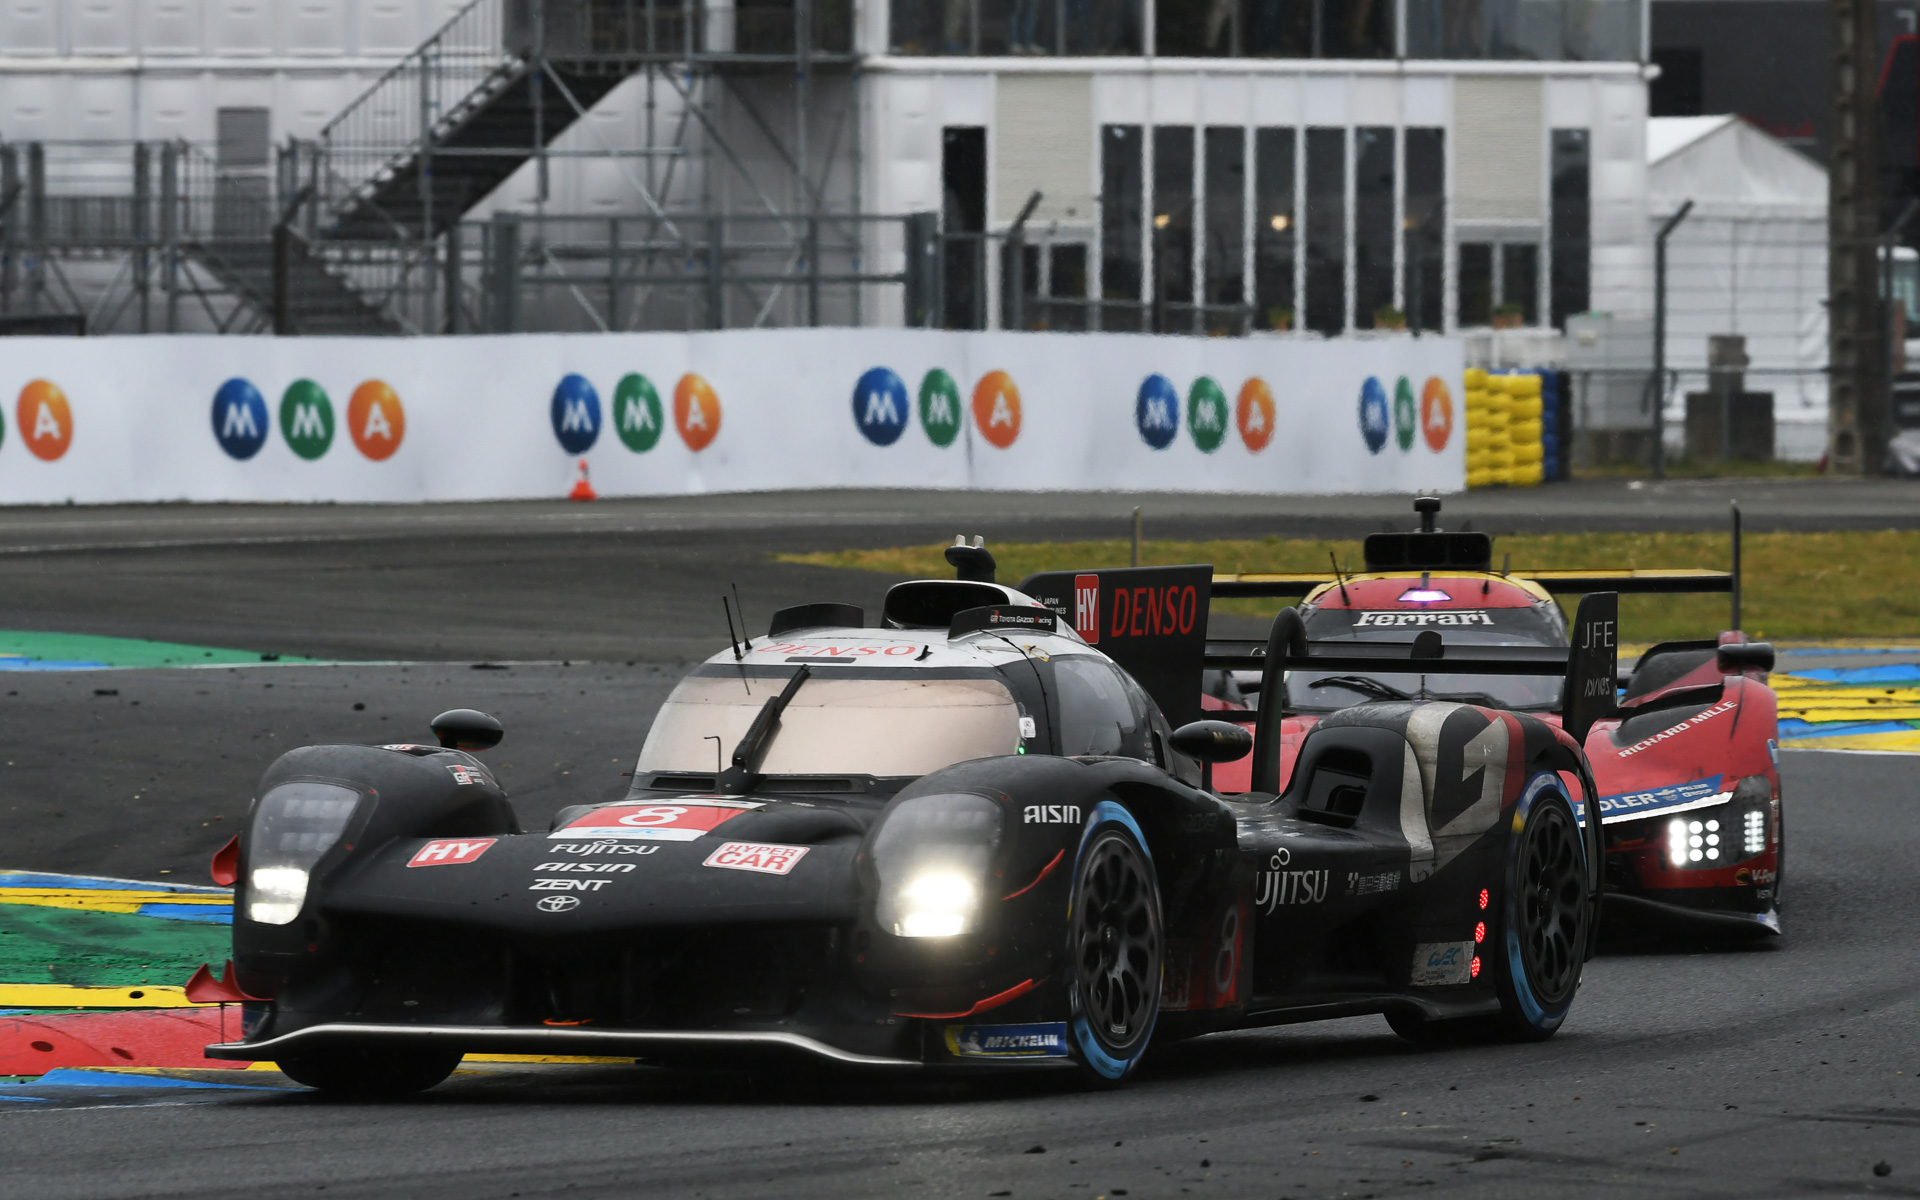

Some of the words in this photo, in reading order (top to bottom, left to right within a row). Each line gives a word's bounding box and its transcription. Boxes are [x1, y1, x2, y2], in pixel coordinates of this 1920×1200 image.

[1043, 597, 1059, 605] JAPAN
[1076, 588, 1097, 631] HY
[1111, 585, 1197, 637] DENSO
[1352, 610, 1495, 627] Ferrari
[999, 615, 1015, 623] TOYOTA
[1035, 616, 1052, 626] Racing
[1581, 621, 1614, 649] JFE
[756, 642, 917, 657] DENSO
[1618, 722, 1690, 758] RICHARD
[1692, 701, 1738, 724] MILLE
[1682, 788, 1713, 798] GROUP
[618, 806, 688, 826] 8
[1023, 805, 1081, 824] AISIN
[421, 843, 480, 861] HY
[549, 841, 661, 857] FUJITSU
[725, 844, 797, 857] HYPER
[533, 862, 637, 873] AISIN
[715, 851, 791, 870] CAR
[528, 878, 612, 891] ZENT
[1255, 863, 1330, 917] UJITSU
[1215, 903, 1239, 994] 8
[984, 1034, 1059, 1048] MICHELIN
